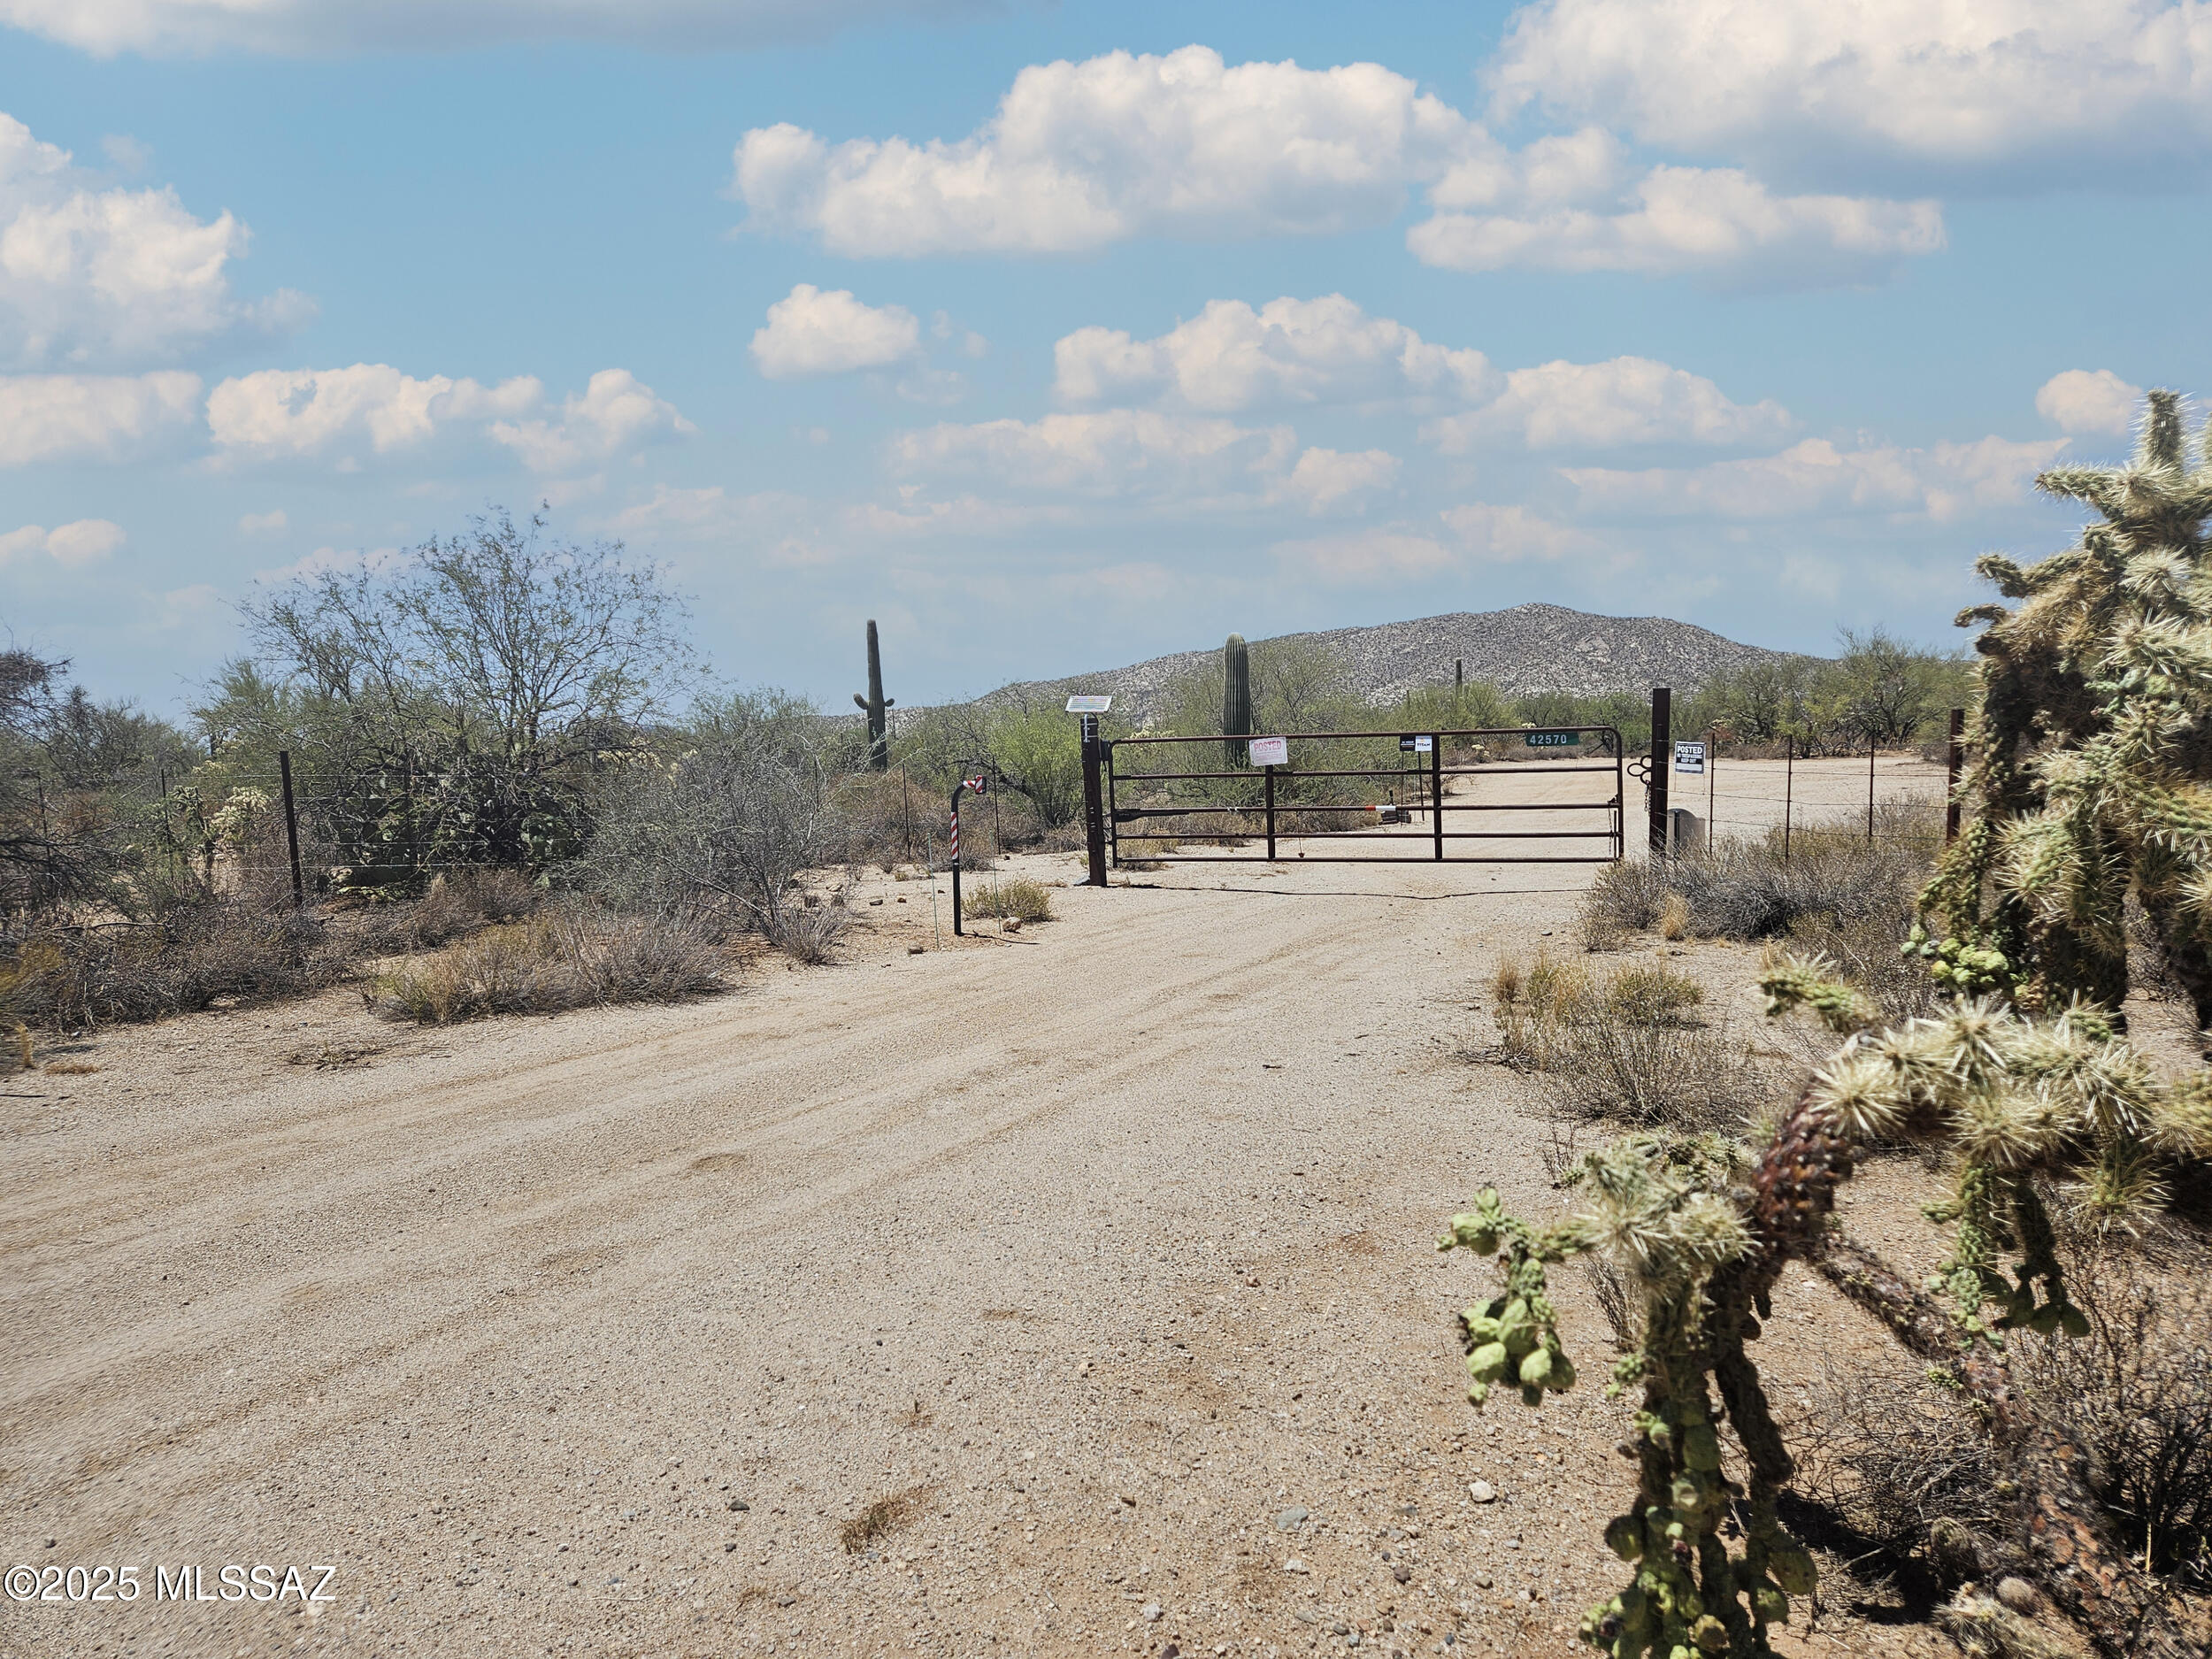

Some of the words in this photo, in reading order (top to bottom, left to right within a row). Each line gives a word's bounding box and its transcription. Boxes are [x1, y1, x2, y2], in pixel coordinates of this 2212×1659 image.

[1530, 734, 1567, 744] 42570
[1254, 740, 1282, 751] POSTED
[1677, 745, 1702, 754] POSTED
